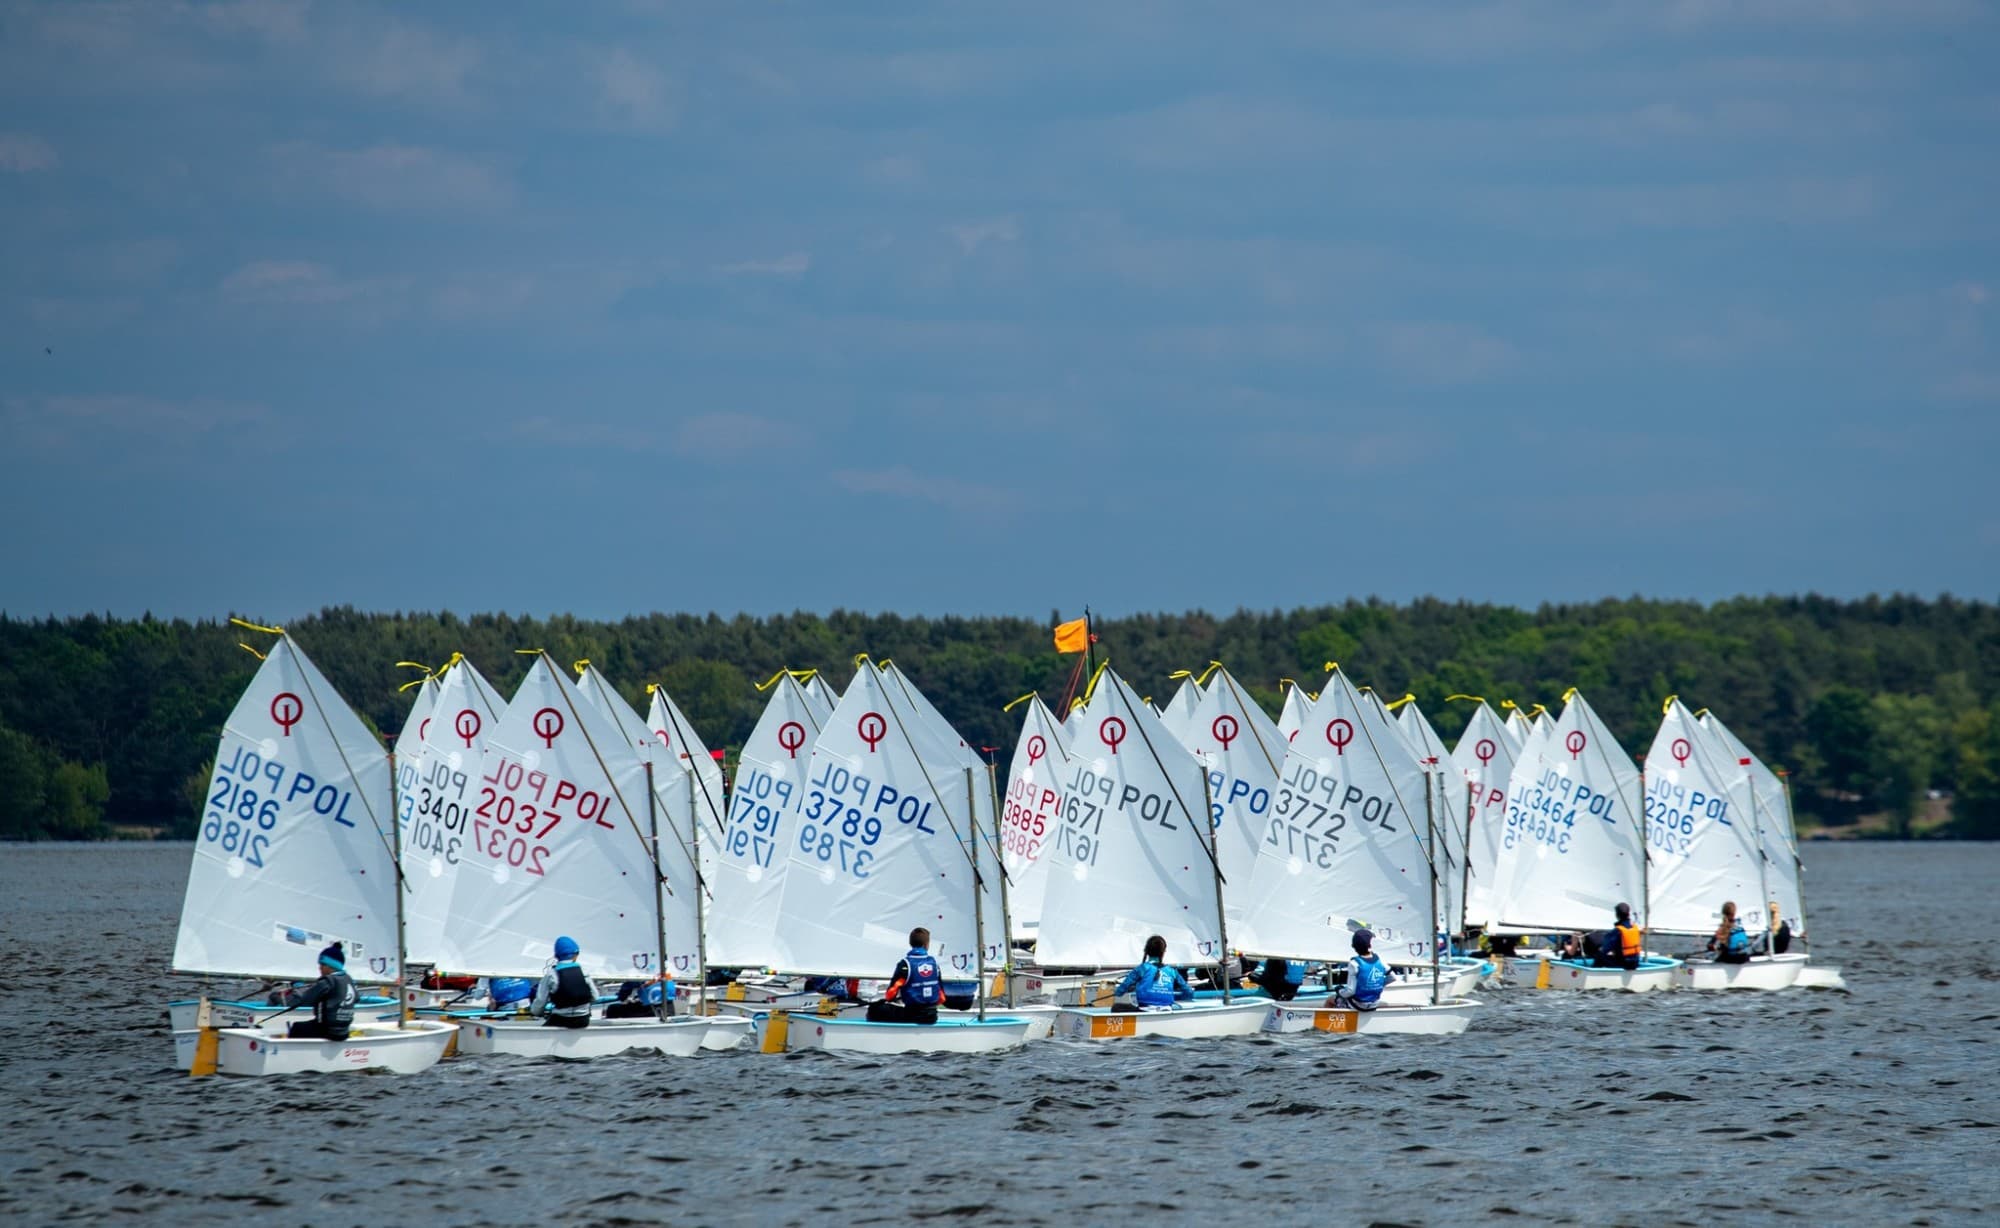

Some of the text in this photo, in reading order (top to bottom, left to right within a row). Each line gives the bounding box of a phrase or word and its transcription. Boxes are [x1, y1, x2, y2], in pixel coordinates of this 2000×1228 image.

[210, 776, 280, 830] 2186
[287, 772, 355, 827] POL
[418, 787, 469, 835] 3401
[475, 788, 562, 839] 2037
[551, 780, 616, 830] POL
[730, 794, 780, 837] 1791
[805, 791, 882, 846] 3789
[873, 784, 936, 835] POL
[1004, 799, 1047, 836] 3885
[1061, 792, 1103, 835] 1671
[1118, 784, 1177, 830] POL
[1228, 779, 1271, 818] PO
[1275, 788, 1346, 842] 3772
[1340, 785, 1397, 833] POL
[1531, 789, 1576, 829] 3464
[1573, 785, 1616, 824] POL
[1645, 796, 1694, 834] 2206
[1689, 791, 1732, 826] POL
